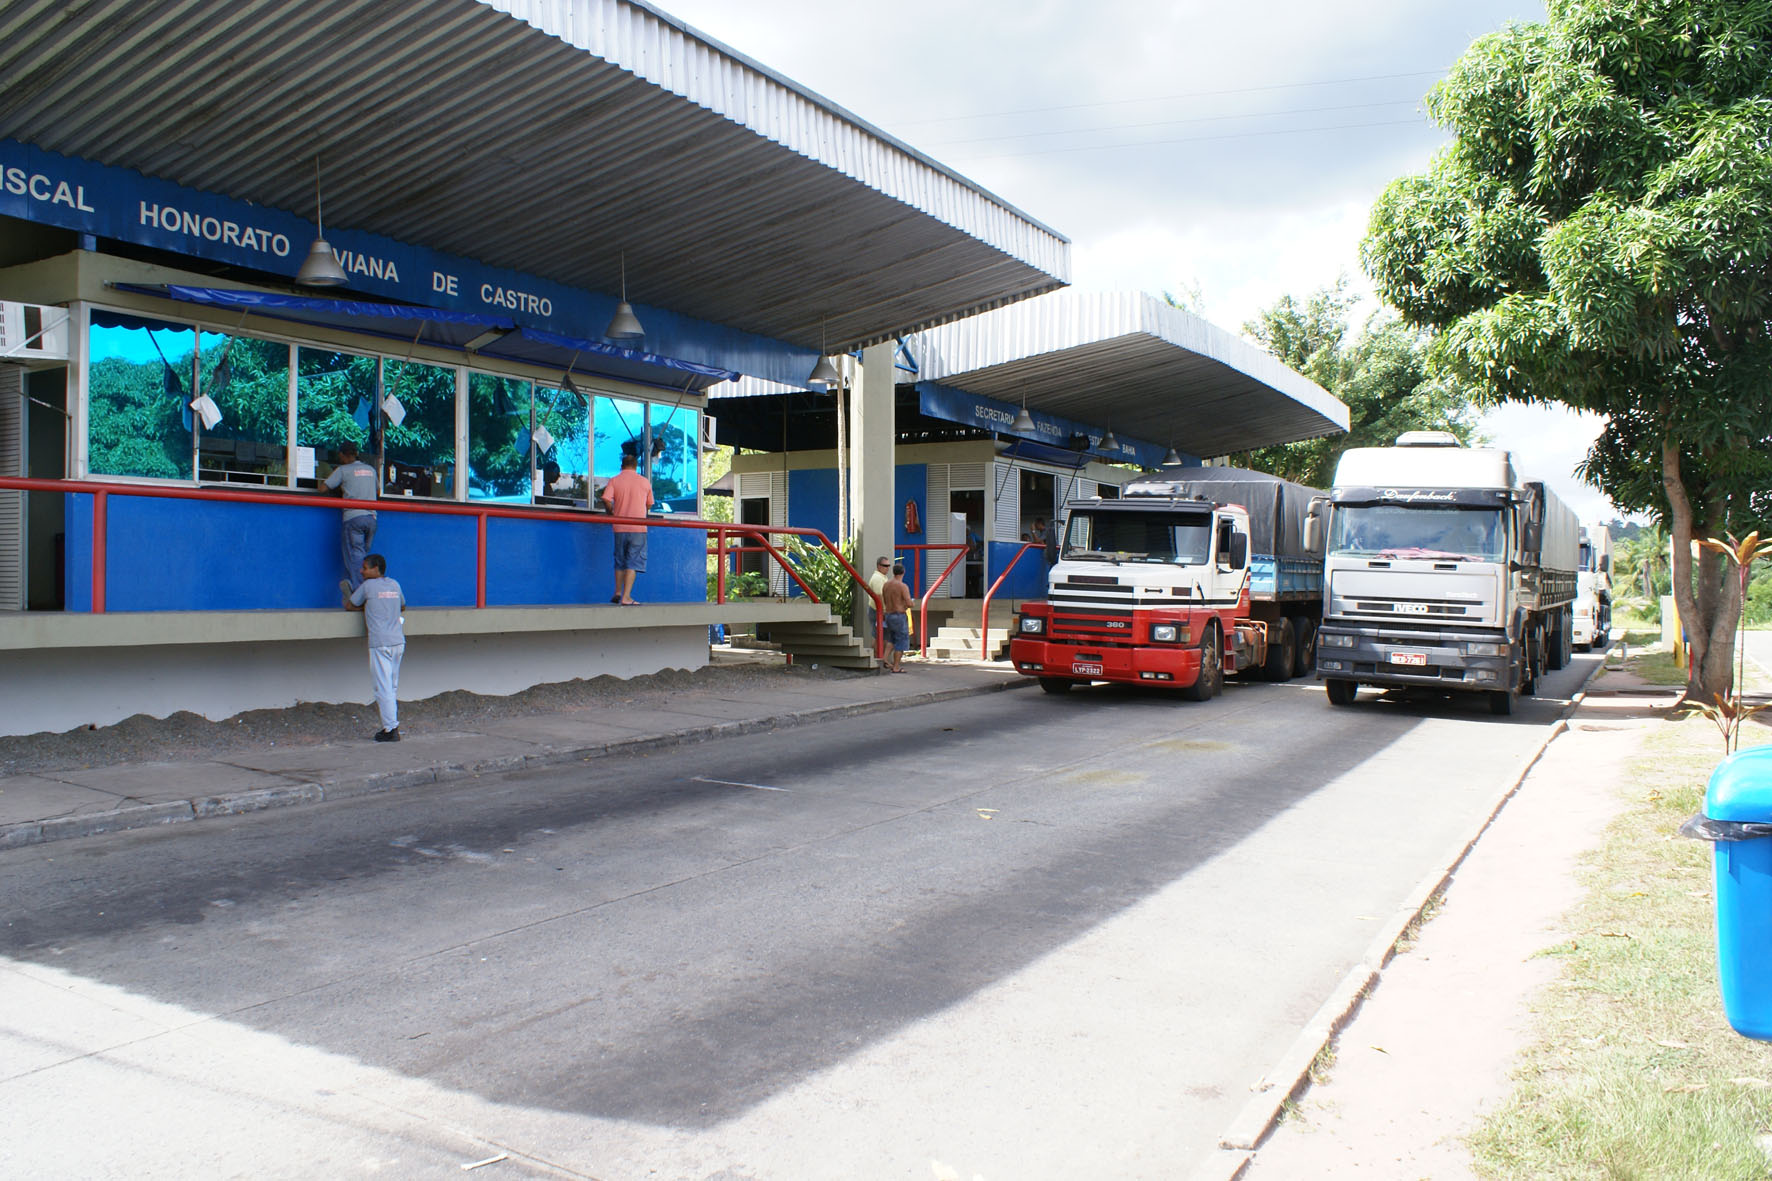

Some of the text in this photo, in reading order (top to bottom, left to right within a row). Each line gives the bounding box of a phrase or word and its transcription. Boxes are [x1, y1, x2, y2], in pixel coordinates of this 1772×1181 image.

[139, 200, 291, 259] HONORATO
[333, 247, 400, 284] VIANA
[432, 271, 460, 297] DE
[480, 282, 555, 319] CASTRO
[975, 405, 1015, 426] SECRETARIA
[1037, 421, 1062, 438] FAZENDA
[1393, 604, 1429, 614] IVECO
